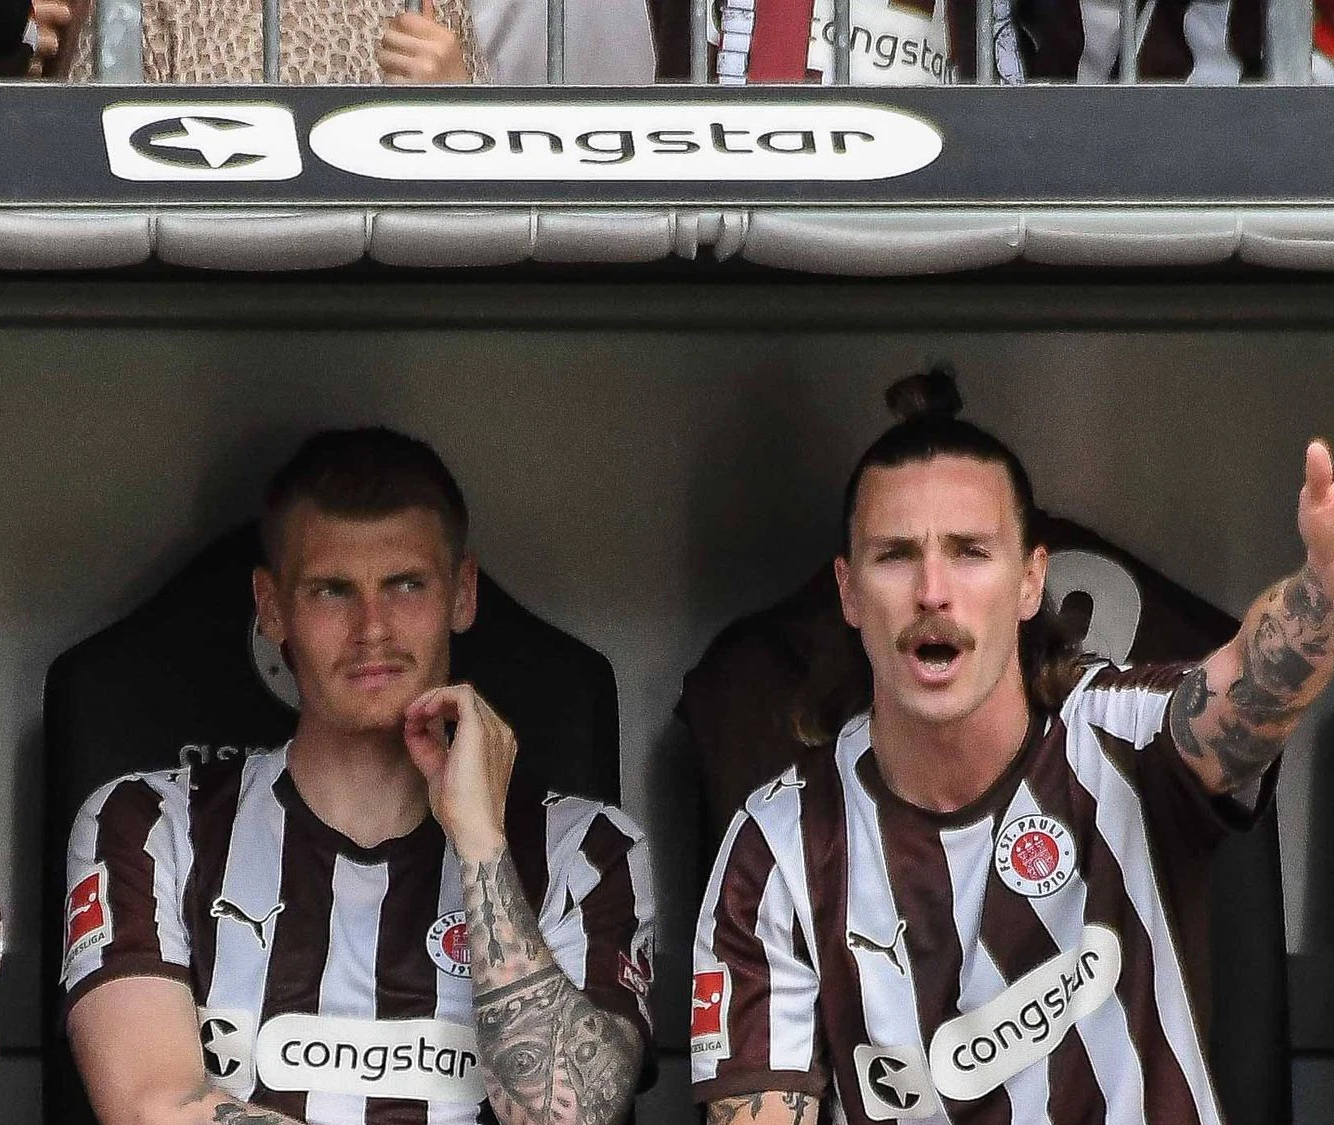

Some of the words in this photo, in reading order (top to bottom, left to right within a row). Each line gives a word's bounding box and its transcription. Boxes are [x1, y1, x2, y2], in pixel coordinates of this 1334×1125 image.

[379, 123, 875, 163] congstar
[1017, 818, 1065, 838] PAULI
[999, 831, 1019, 850] ST.
[997, 856, 1012, 873] FC
[1037, 870, 1066, 894] 1910
[429, 925, 443, 941] FC
[441, 914, 464, 928] ST.
[450, 963, 473, 976] 191
[951, 951, 1100, 1071] congstar
[280, 1037, 478, 1081] congstar
